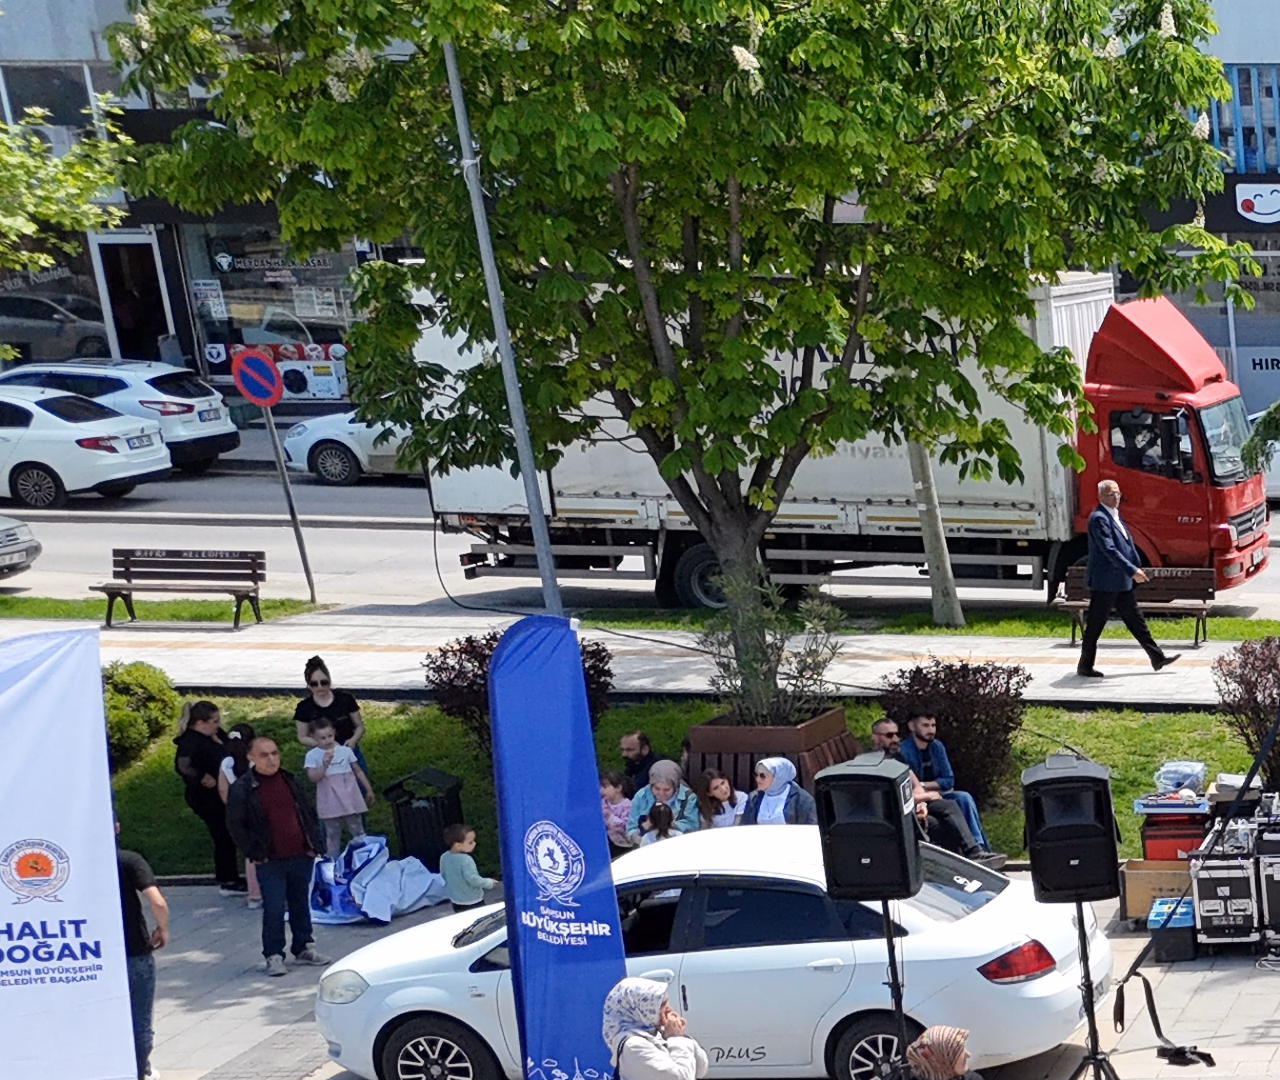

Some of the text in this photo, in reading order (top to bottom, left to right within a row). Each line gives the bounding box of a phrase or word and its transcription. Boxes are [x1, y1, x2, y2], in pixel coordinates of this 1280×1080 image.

[521, 911, 611, 937] BÜYÜKŞEHİR
[537, 931, 588, 946] BELEDİYESİ
[0, 941, 102, 964] OĞAN
[0, 964, 103, 977] MSUN BÜYÜKŞEHİR
[0, 974, 98, 987] ELEDİYE BAŞKANI
[709, 1045, 767, 1063] PLUS
